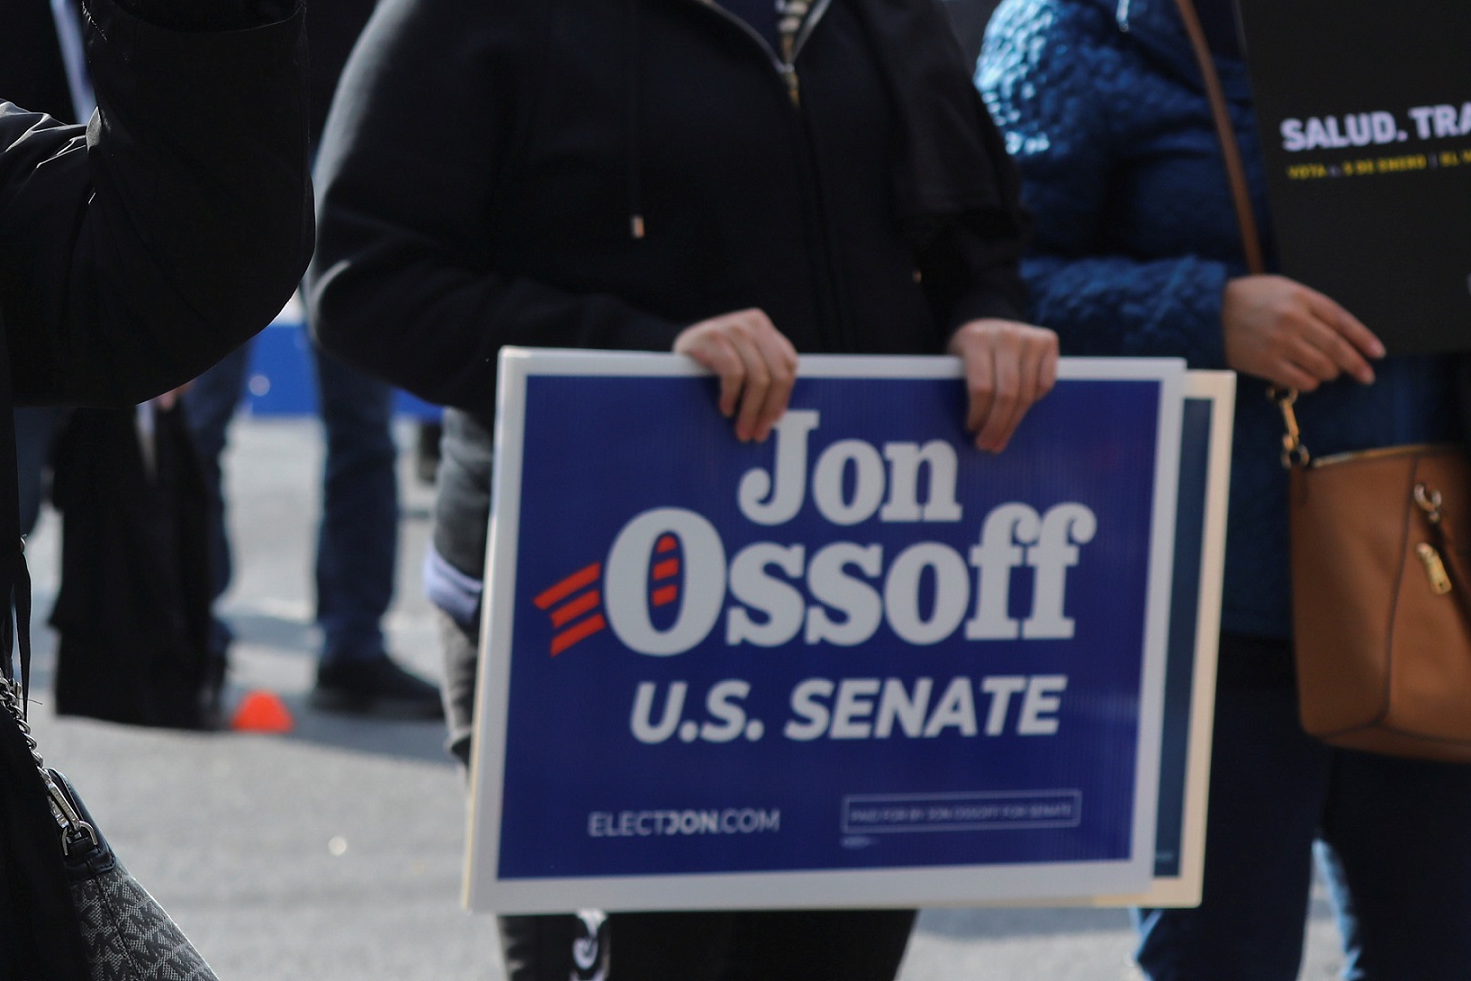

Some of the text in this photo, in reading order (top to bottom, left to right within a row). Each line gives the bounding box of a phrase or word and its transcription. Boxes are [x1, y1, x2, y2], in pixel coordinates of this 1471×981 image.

[1281, 111, 1408, 152] SALUD.
[737, 410, 962, 525] Jon
[604, 503, 1097, 656] Ossoff
[631, 675, 1068, 743] U.S. SENATE
[588, 808, 780, 837] ELECTJON.COM
